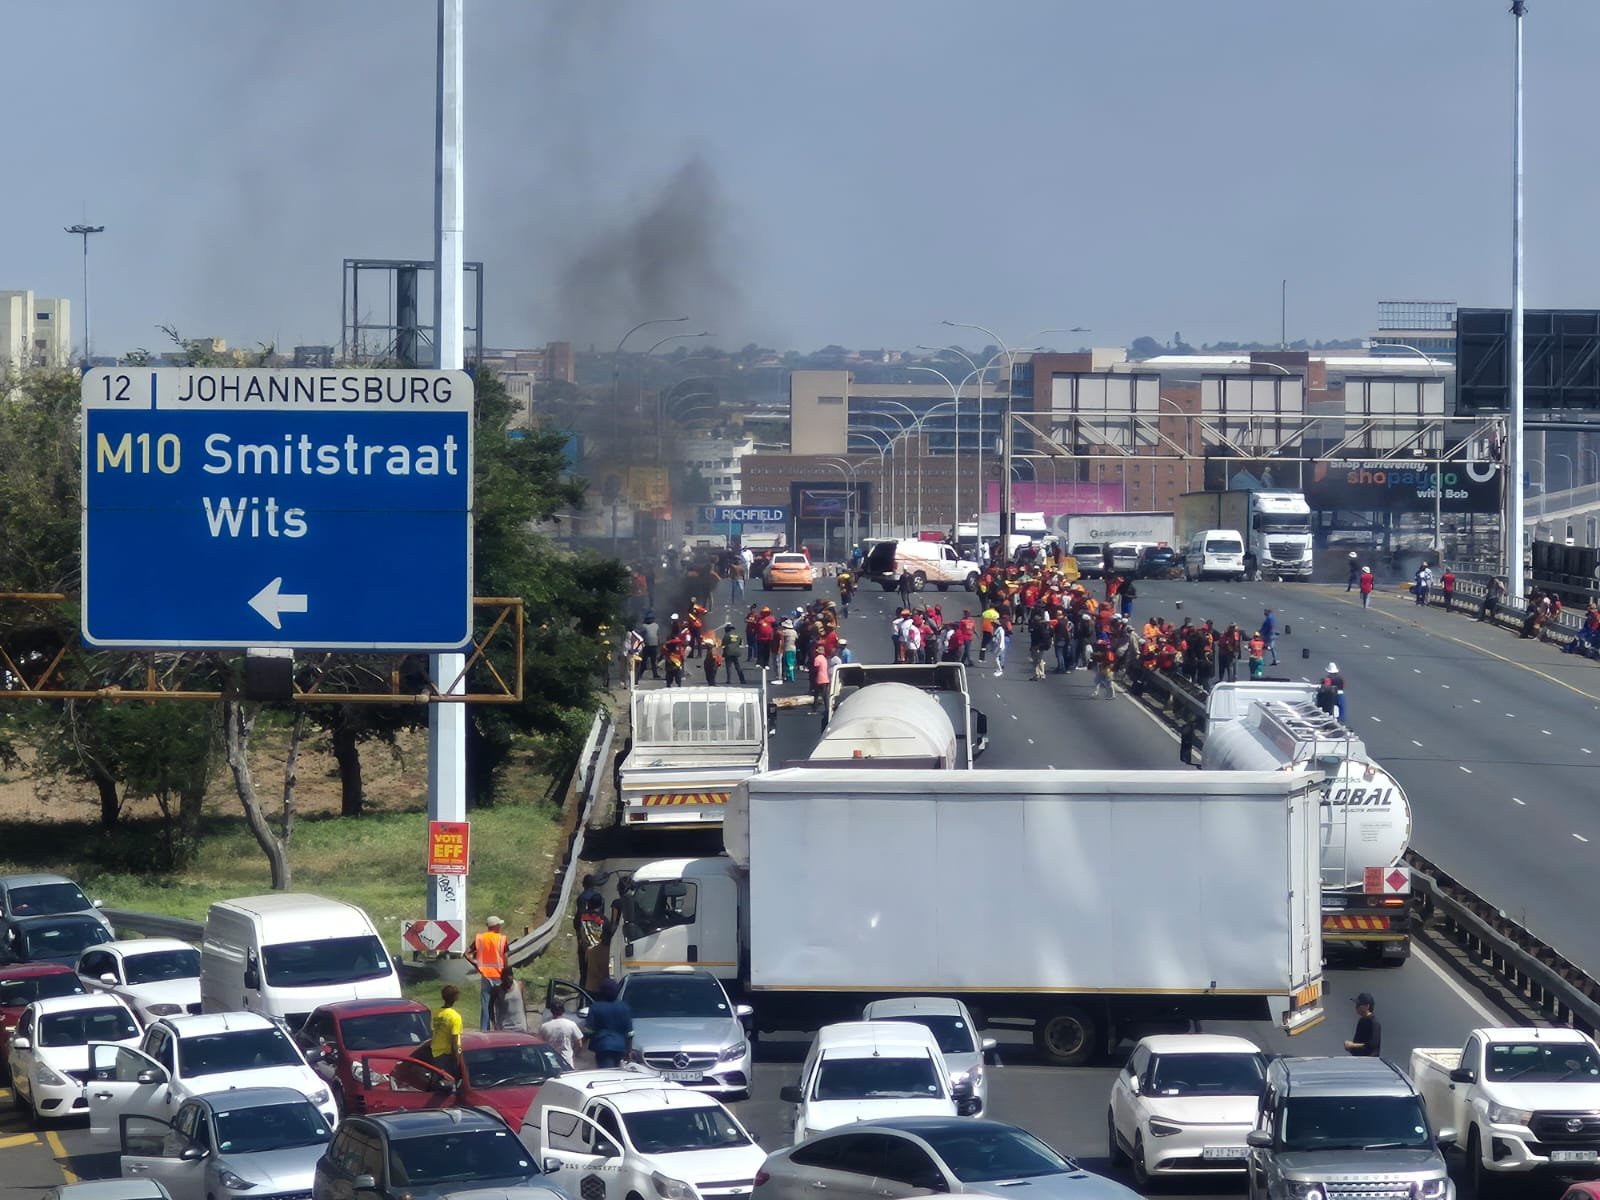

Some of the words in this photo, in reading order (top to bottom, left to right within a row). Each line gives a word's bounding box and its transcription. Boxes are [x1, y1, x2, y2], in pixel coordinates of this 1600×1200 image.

[102, 375, 131, 400] 12
[178, 375, 453, 403] JOHANNESBURG
[97, 433, 181, 474] M10
[203, 433, 458, 475] Smitstraat
[1445, 489, 1469, 499] Bob
[203, 497, 308, 537] Wits
[722, 509, 783, 521] RICHFIELD
[1320, 787, 1393, 806] LOBAL
[434, 834, 463, 844] VOTE
[434, 844, 463, 858] EFF
